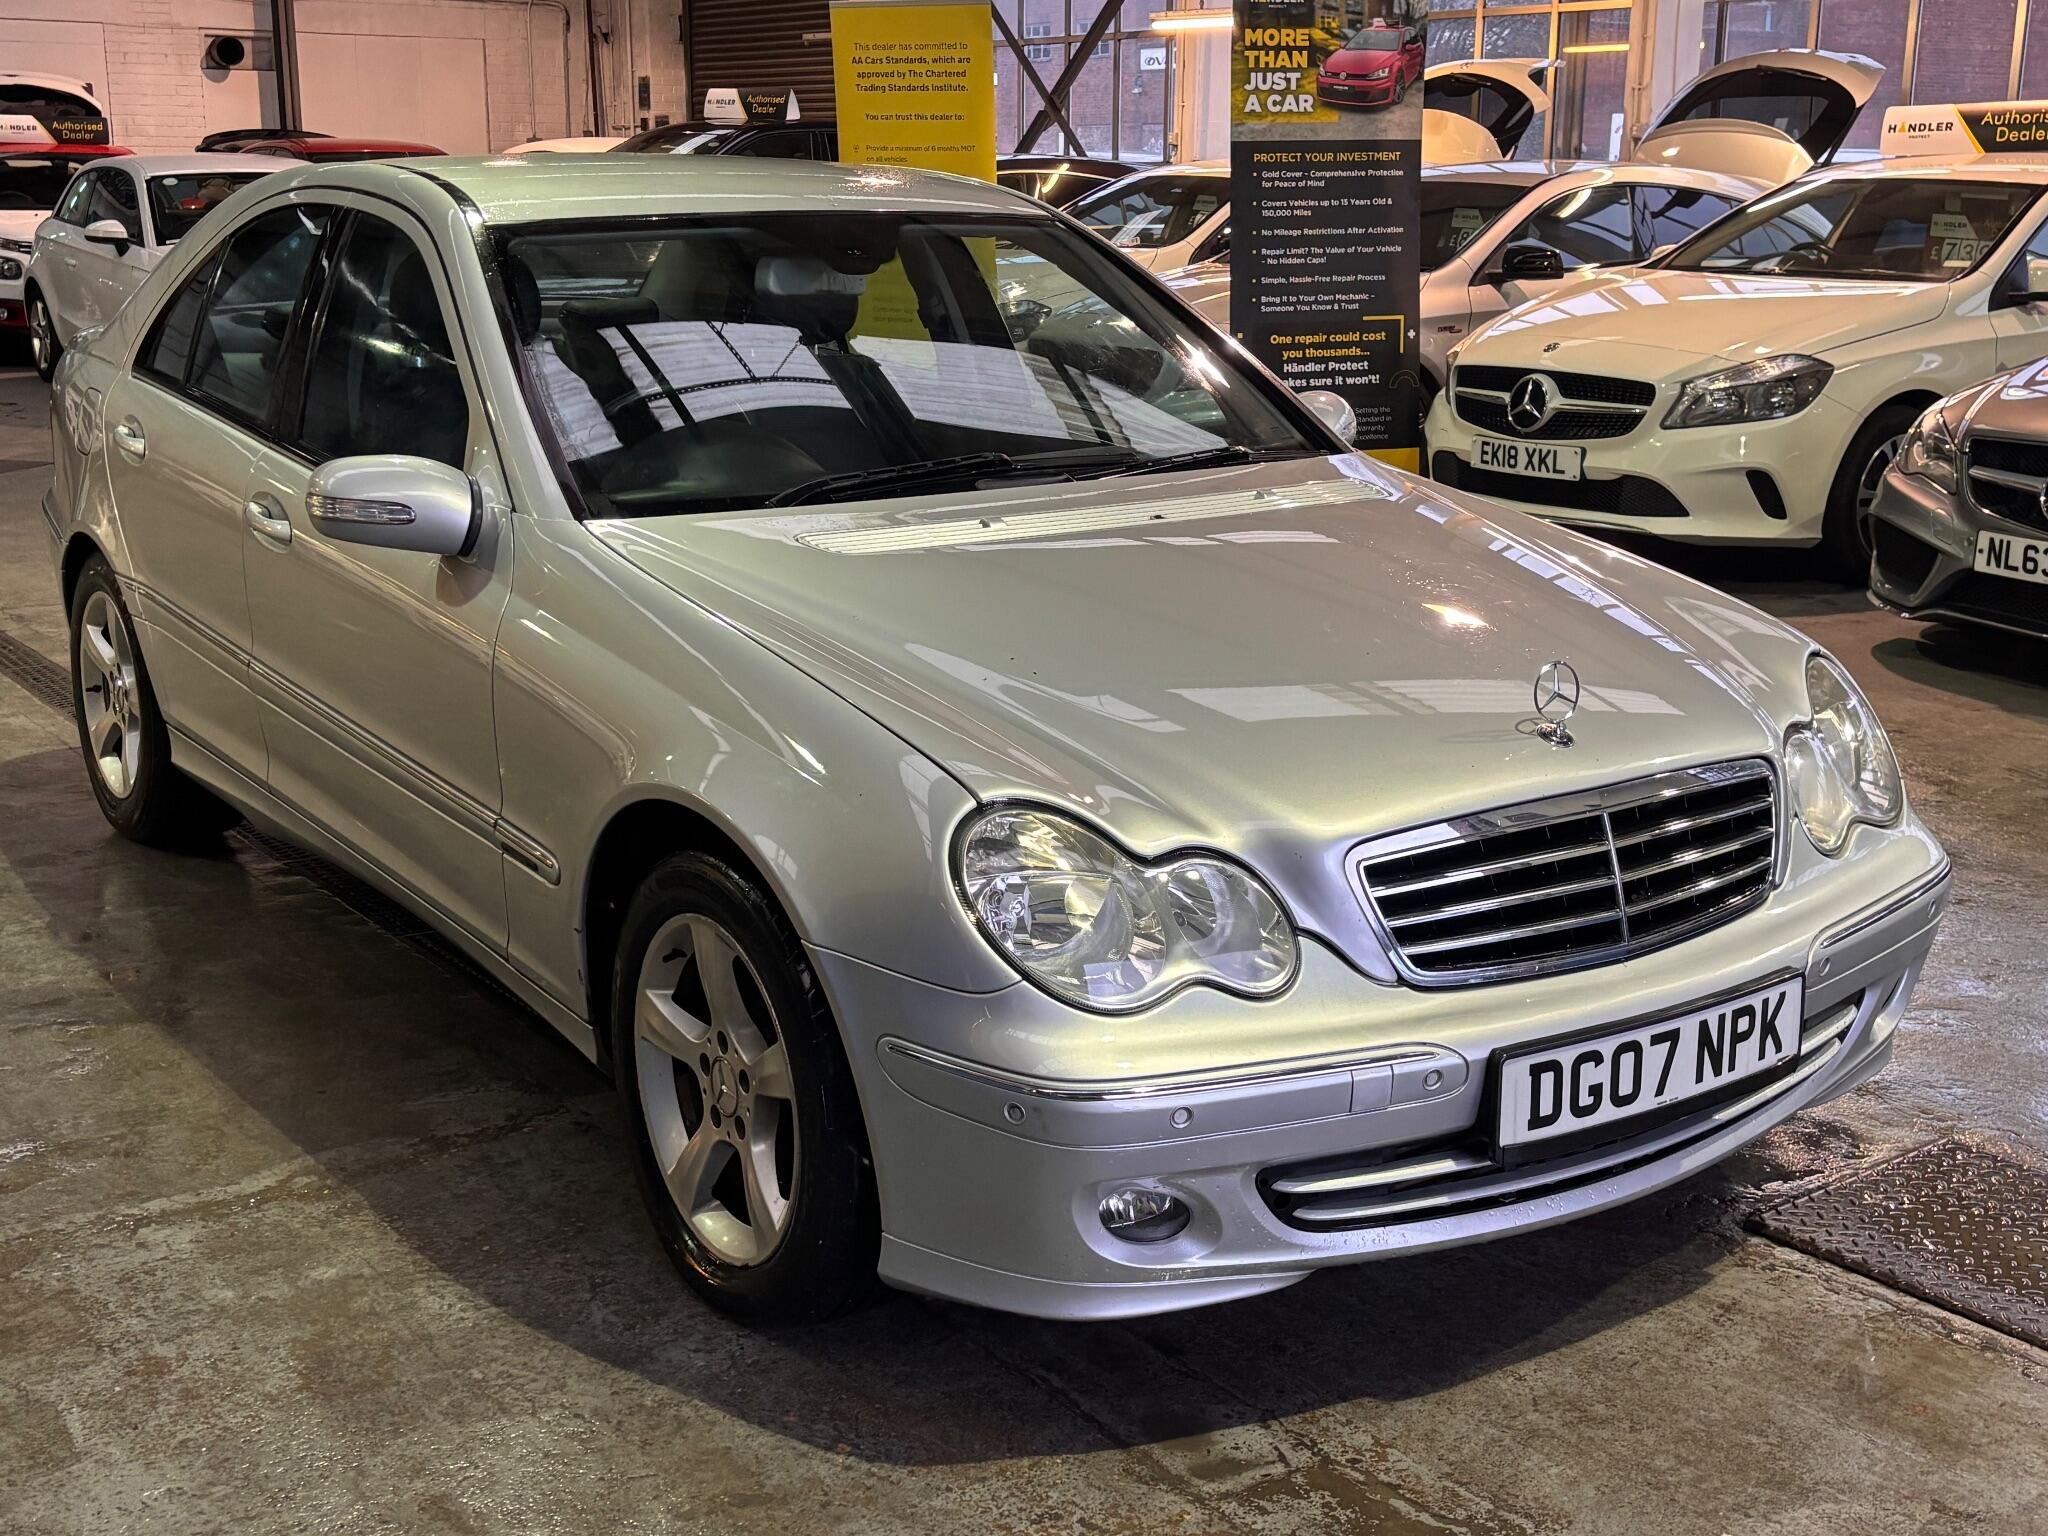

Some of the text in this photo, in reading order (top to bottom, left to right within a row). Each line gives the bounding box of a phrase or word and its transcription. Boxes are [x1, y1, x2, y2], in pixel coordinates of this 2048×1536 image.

[1244, 28, 1310, 47] MORE
[854, 43, 870, 51] This
[914, 42, 956, 50] committed
[959, 42, 968, 50] to
[852, 56, 863, 64] AA
[865, 56, 884, 64] Cars
[885, 56, 930, 66] Standards,
[932, 56, 956, 64] which
[1244, 50, 1308, 68] THAN
[856, 69, 967, 80] approved by The Chartered
[1244, 72, 1301, 91] JUST
[855, 83, 969, 94] Trading Standards Institute.
[746, 94, 786, 104] Authorised
[1244, 94, 1314, 112] A CAR
[752, 104, 777, 114] Dealer
[864, 113, 879, 121] You
[914, 112, 928, 120] this
[930, 112, 953, 120] dealer
[52, 120, 103, 131] Authorised
[62, 130, 94, 140] Dealer
[1996, 124, 2048, 142] Deale
[1254, 152, 1401, 162] PROTECT YOUR INVESTMENT
[1262, 170, 1280, 178] Gold
[1281, 170, 1303, 178] Cover
[1310, 169, 1366, 178] Comprehensive
[1368, 168, 1404, 176] Protection
[1262, 200, 1287, 208] Covers
[1289, 198, 1318, 207] Vehicles
[1320, 200, 1330, 208] up
[1262, 210, 1292, 218] 150,000
[1274, 228, 1302, 236] Mileage
[1304, 228, 1346, 236] Restrictions
[1262, 248, 1285, 256] Repair
[1306, 256, 1326, 264] Caps!
[1261, 276, 1288, 284] Simple,
[1290, 275, 1330, 283] Hassle-Free
[1332, 274, 1356, 282] Repair
[1261, 296, 1280, 304] Bring
[1270, 331, 1386, 345] One repair could cost
[1282, 346, 1370, 360] you thousands...
[1328, 360, 1368, 371] Protect
[1282, 377, 1307, 388] akes
[1309, 376, 1332, 386] sure
[1334, 375, 1344, 386] it
[1480, 440, 1566, 474] EK18 XKL
[1528, 991, 1787, 1132] DG07 NPK
